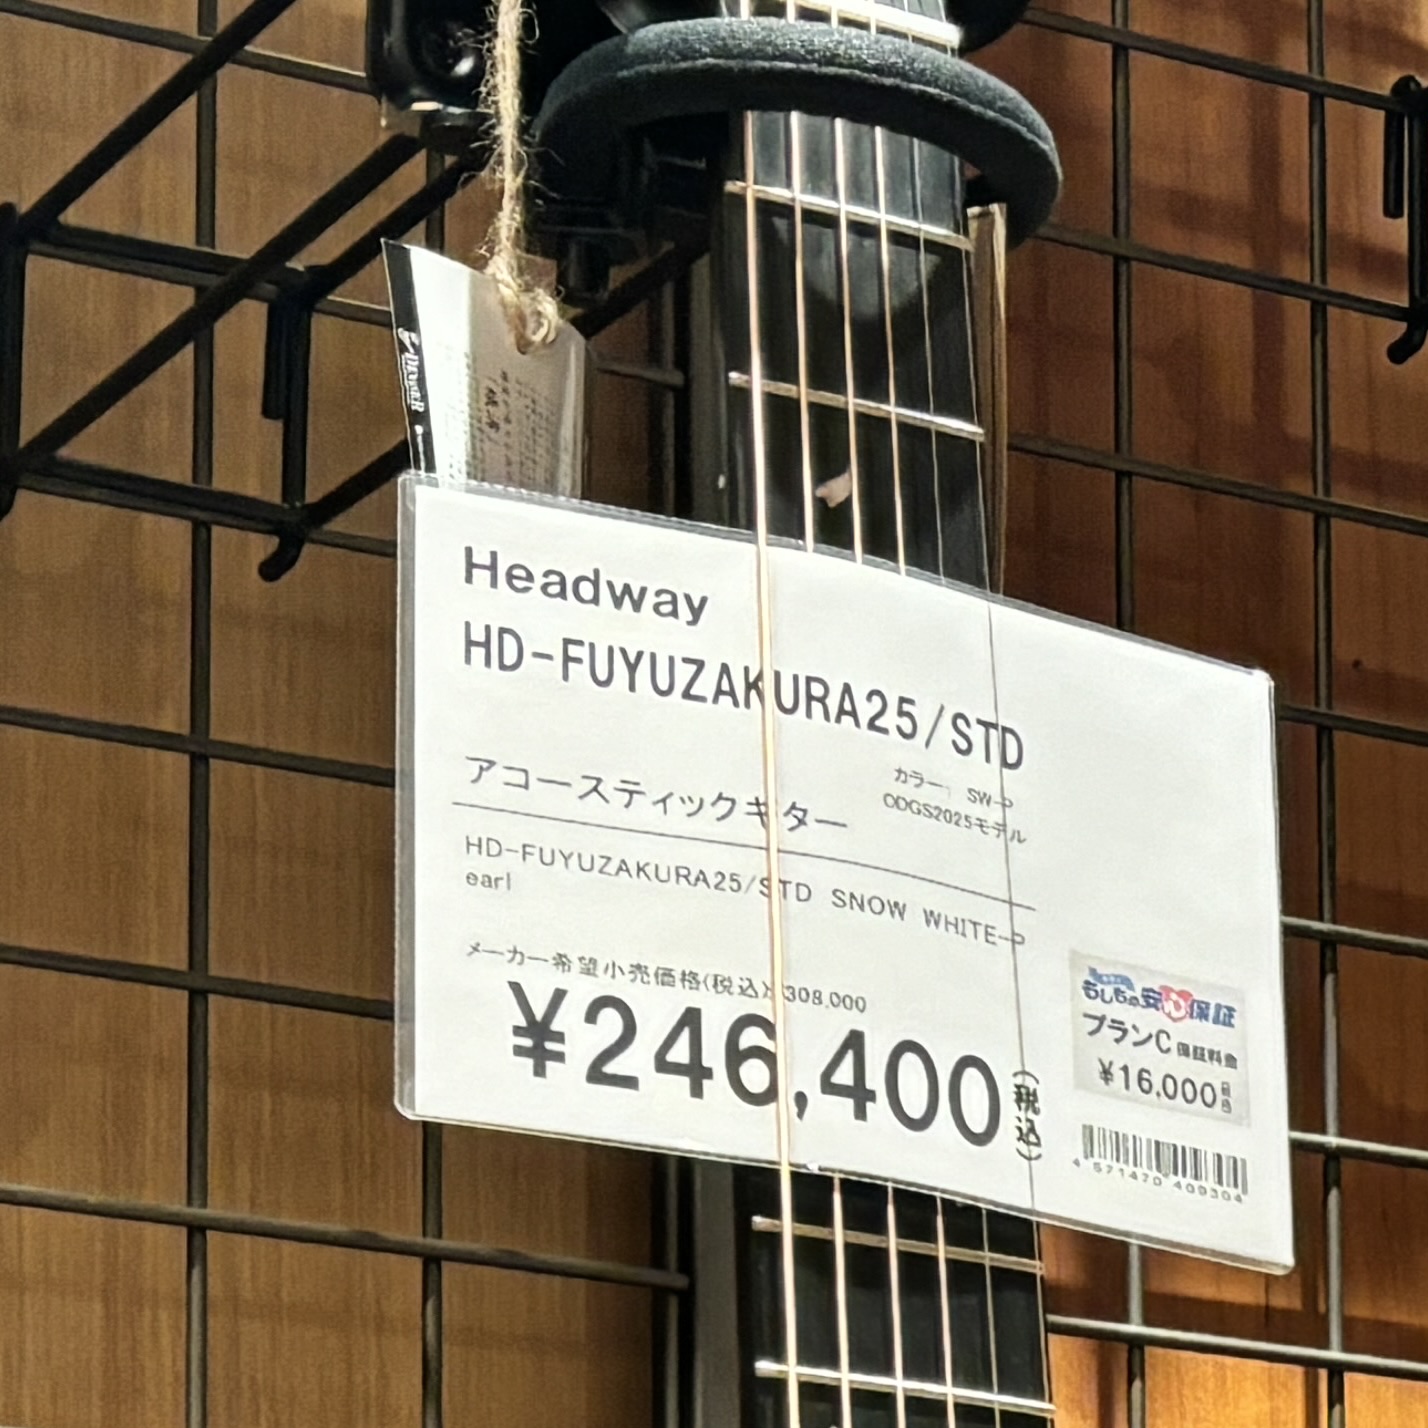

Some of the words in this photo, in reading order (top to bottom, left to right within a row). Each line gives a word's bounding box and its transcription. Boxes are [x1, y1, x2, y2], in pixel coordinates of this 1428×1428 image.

[463, 545, 710, 625] Headway
[463, 621, 1026, 773] HD-FUYUZAKURA25/STD
[465, 753, 849, 833] アコースティックギター
[465, 870, 512, 893] earl
[830, 889, 908, 922] SNOW
[508, 981, 1002, 1147] ¥246,400
